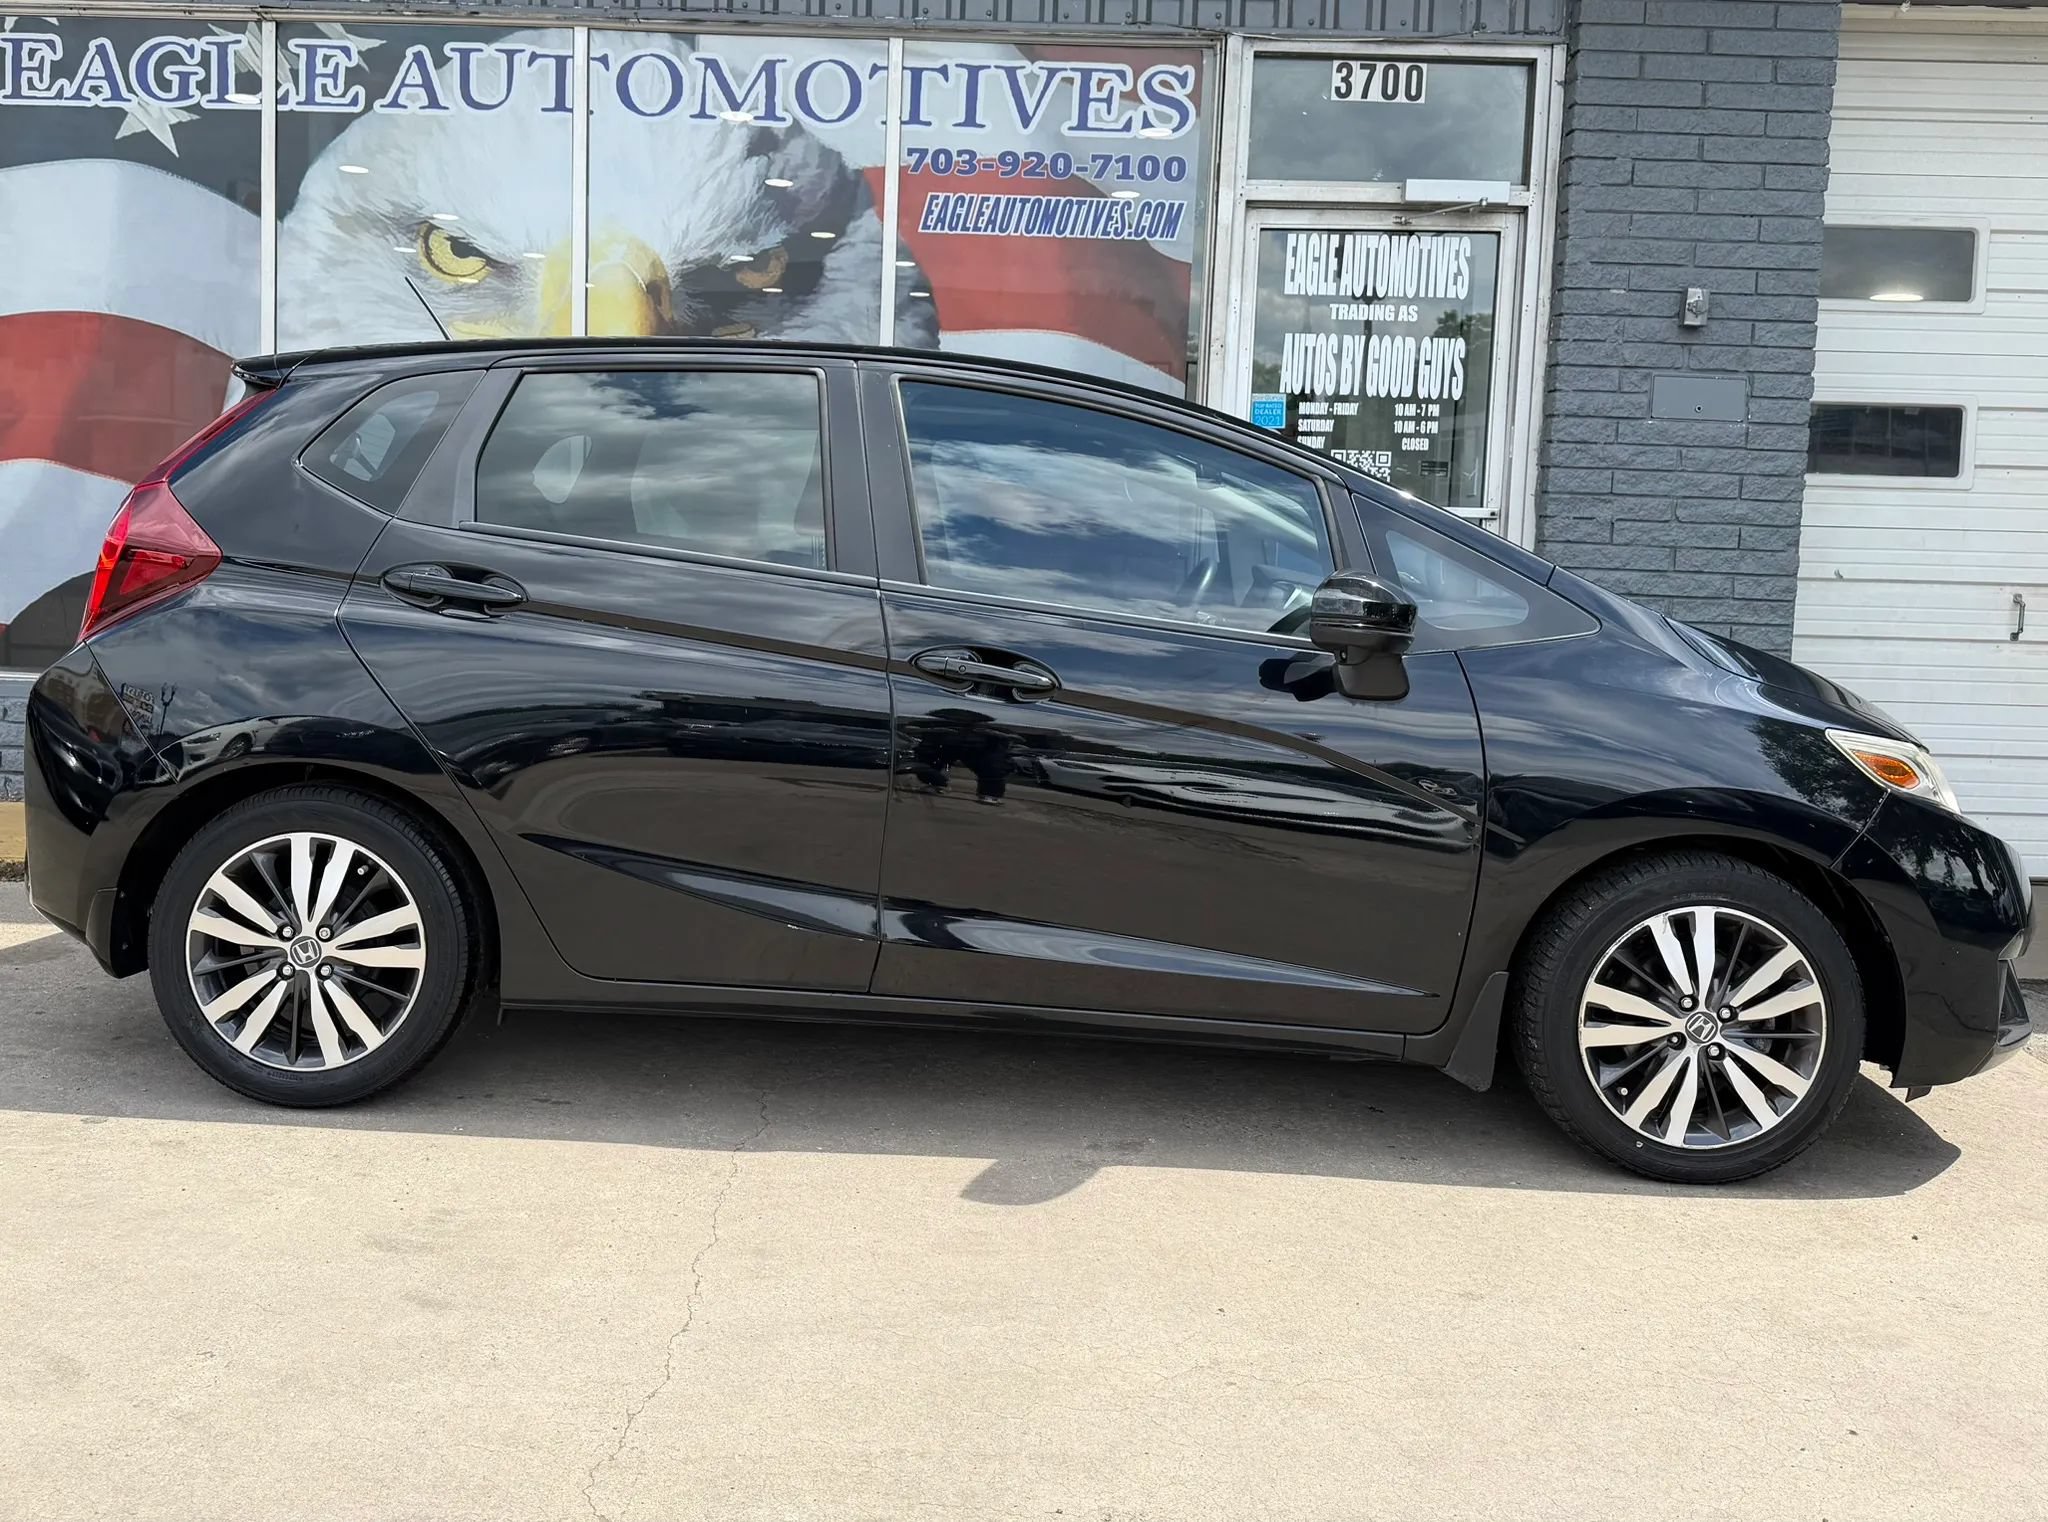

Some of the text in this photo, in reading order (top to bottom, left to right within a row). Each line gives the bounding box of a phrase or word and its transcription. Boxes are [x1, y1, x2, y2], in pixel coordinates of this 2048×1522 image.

[0, 34, 1195, 136] EAGLE AUTOMOTIVES
[1335, 62, 1424, 102] 3700
[907, 148, 1187, 182] 703-920-7100
[918, 192, 1186, 241] EAGLEAUTOMOTIVES.COM
[1284, 233, 1472, 300] EAGLE AUTOMOTIVES
[1330, 303, 1418, 322] TRADING AS
[1279, 333, 1466, 401] AUTOS BY GOOD GUYS
[1298, 402, 1329, 415] MONDAY
[1333, 402, 1359, 416] FRIDAY
[1394, 403, 1404, 416] 10
[1404, 403, 1416, 416] AM
[1428, 404, 1440, 417] PM
[1255, 415, 1281, 425] 2021
[1298, 418, 1335, 432] SATURDAY
[1393, 420, 1403, 434] 10
[1403, 420, 1416, 434] AM
[1427, 421, 1439, 434] PM
[1402, 437, 1430, 451] CLOSED
